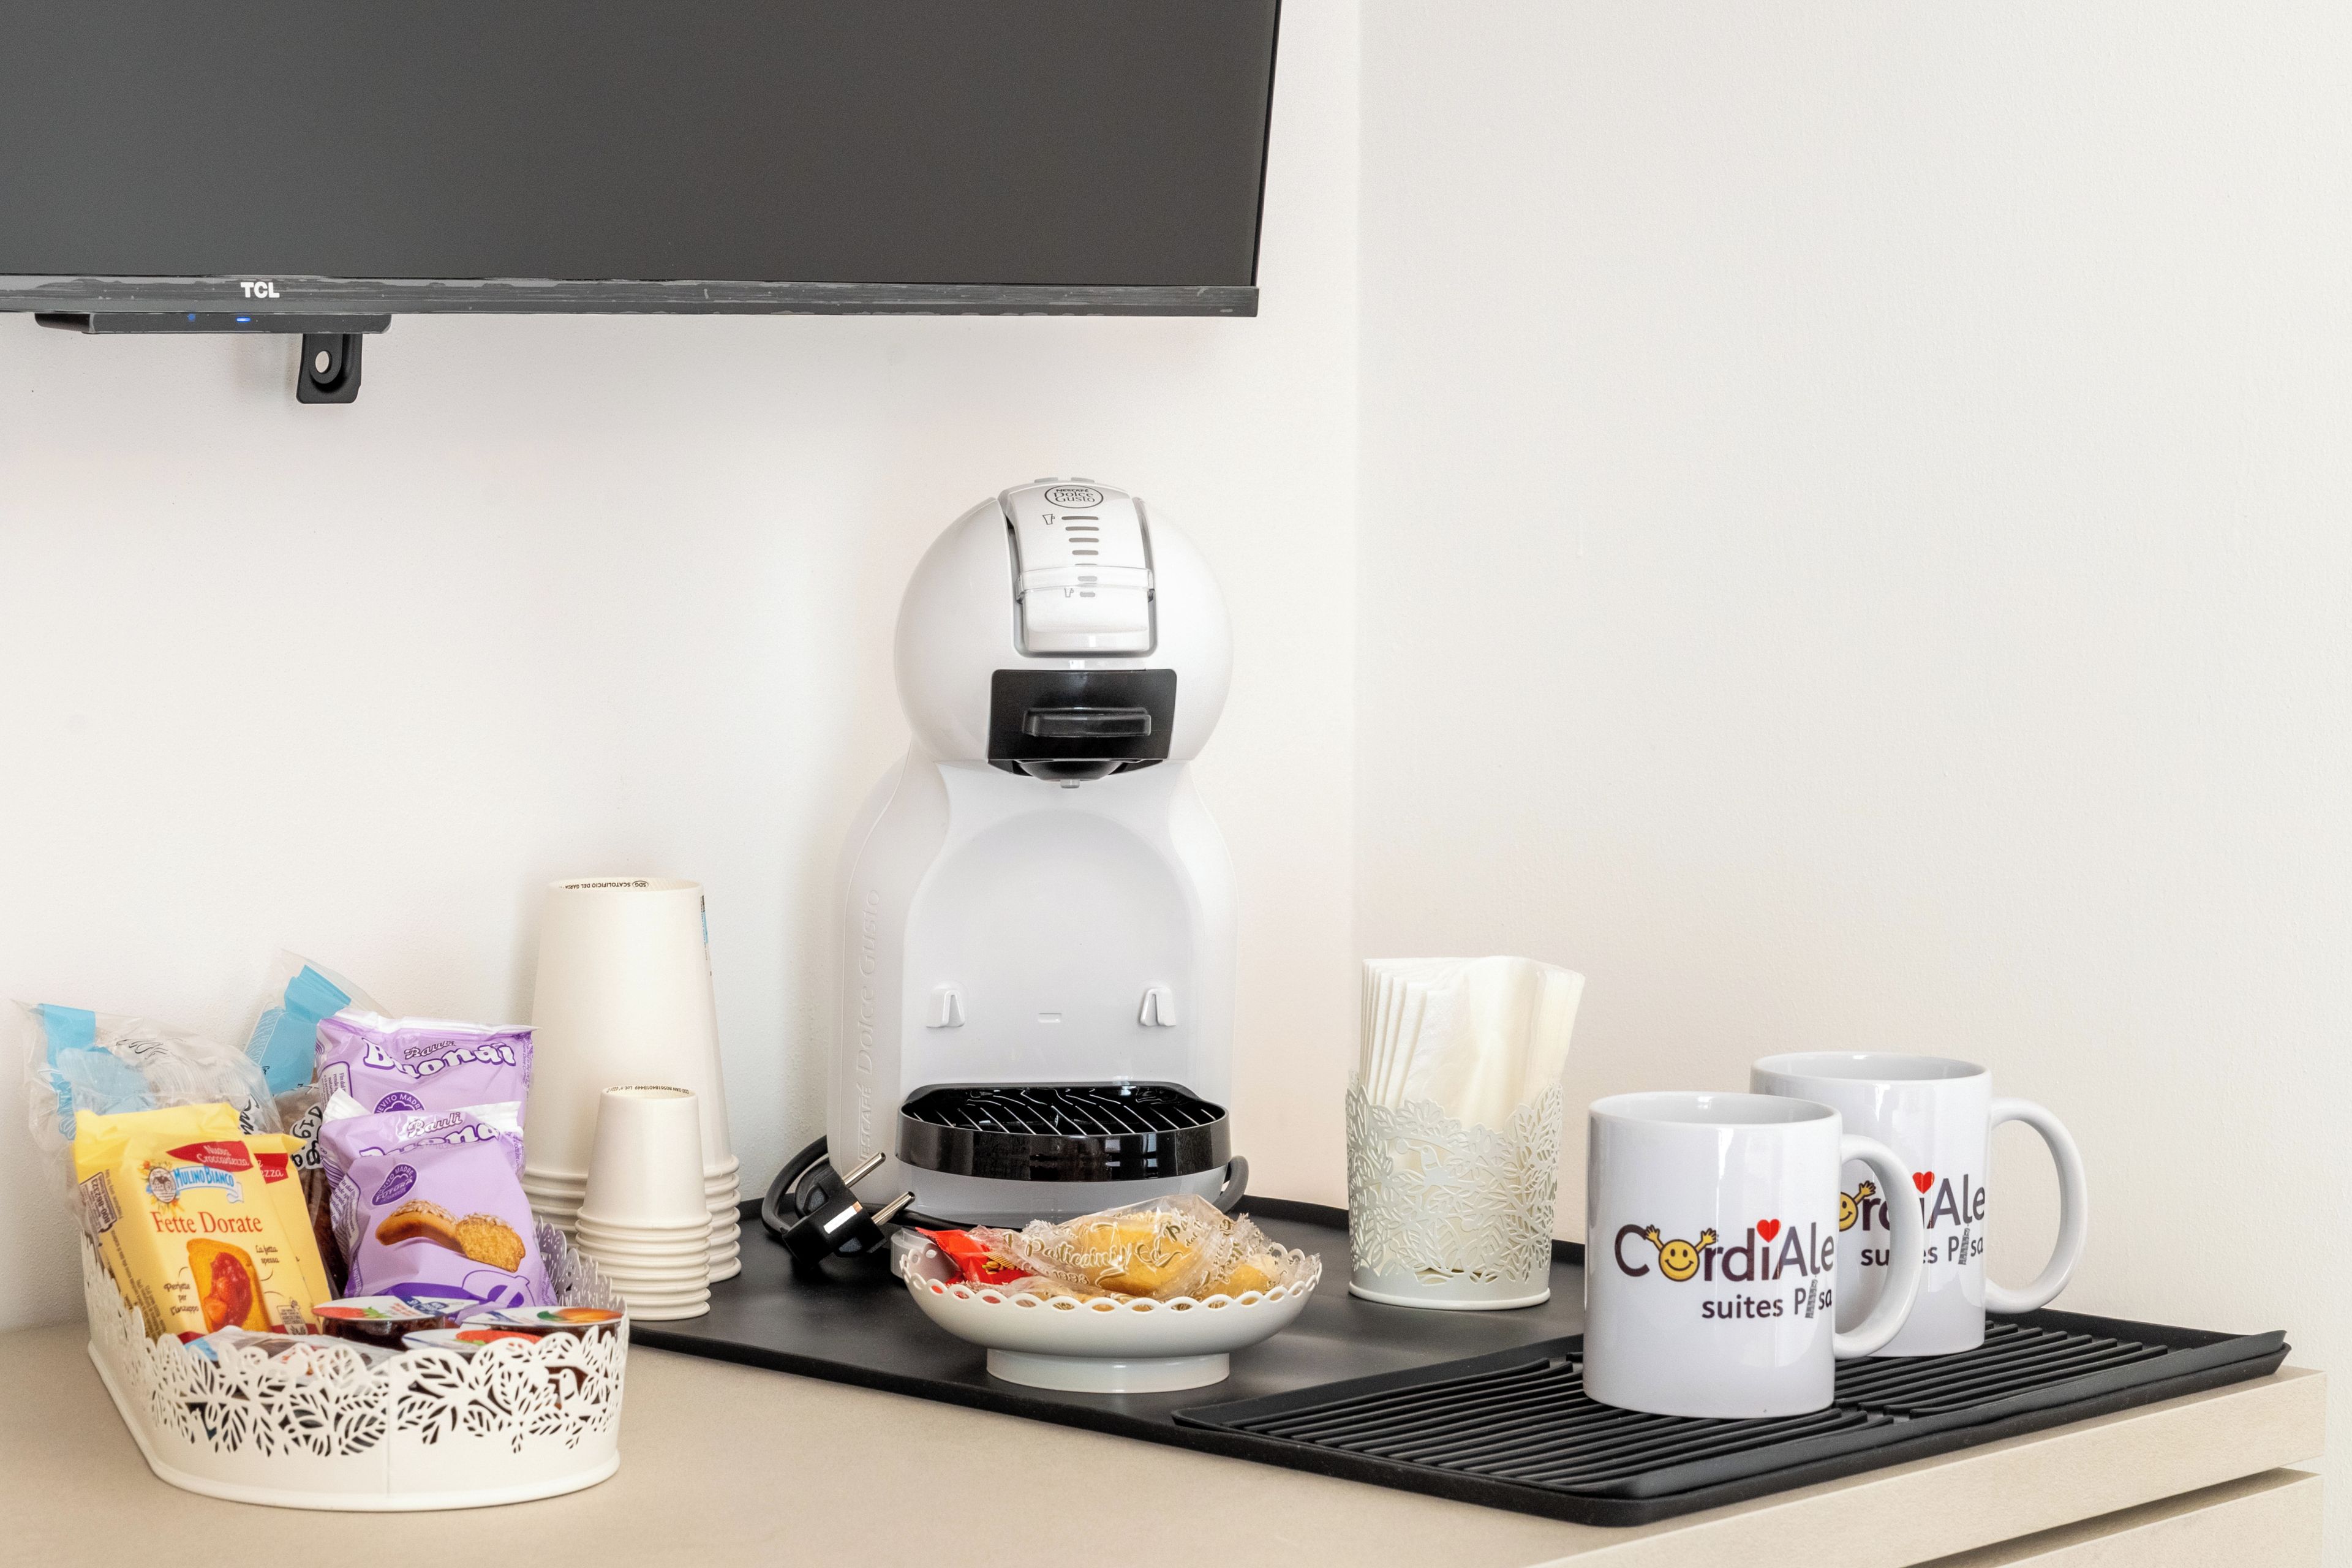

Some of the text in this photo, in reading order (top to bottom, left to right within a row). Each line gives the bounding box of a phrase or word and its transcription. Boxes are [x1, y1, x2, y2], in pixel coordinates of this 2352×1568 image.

[241, 282, 280, 298] TCL
[858, 889, 881, 978] Gusto
[856, 986, 875, 1076] Dolce
[407, 1112, 463, 1138] Bauli
[173, 1167, 204, 1188] MULINO
[204, 1166, 235, 1188] BIANCO
[151, 1211, 263, 1234] Fette Dorate
[1053, 1270, 1089, 1285] 1993
[1702, 1294, 1784, 1319] suites
